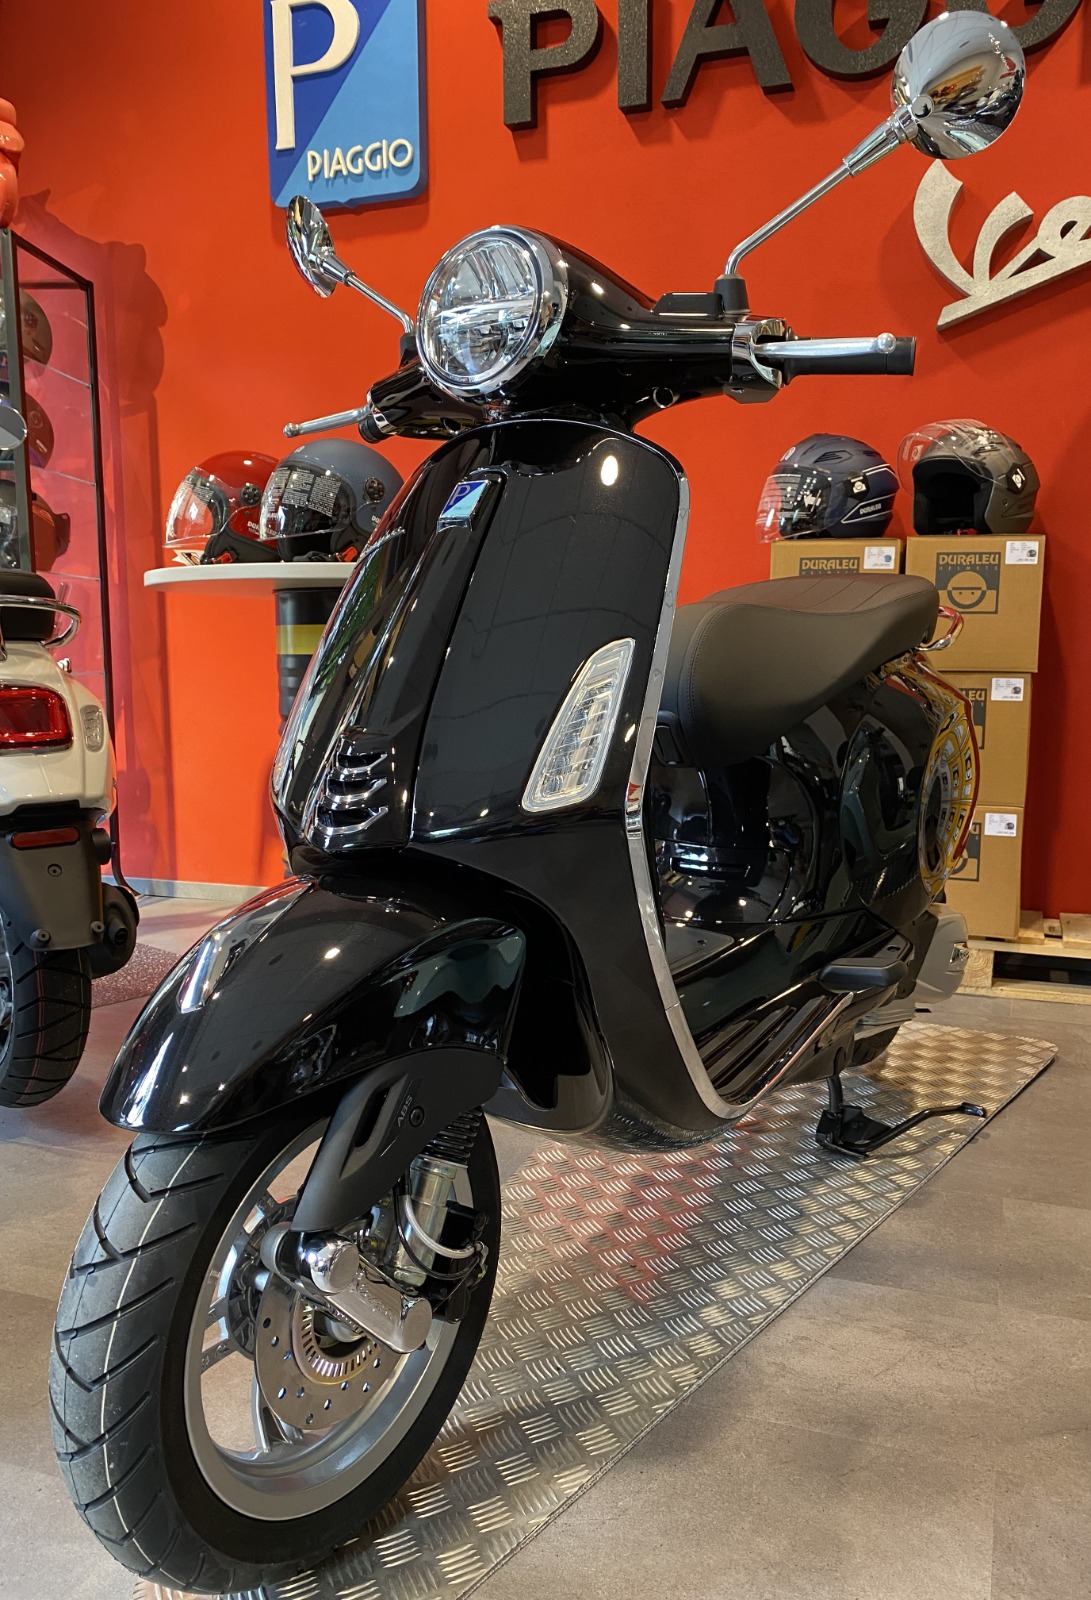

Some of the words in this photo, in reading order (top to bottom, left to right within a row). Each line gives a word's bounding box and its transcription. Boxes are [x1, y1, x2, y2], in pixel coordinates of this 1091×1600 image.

[270, 0, 360, 151] P
[306, 138, 414, 182] PIAGGIO
[448, 484, 471, 506] P
[801, 559, 858, 571] DURALEU
[939, 554, 999, 566] DURALEU
[397, 1094, 413, 1128] ABS
